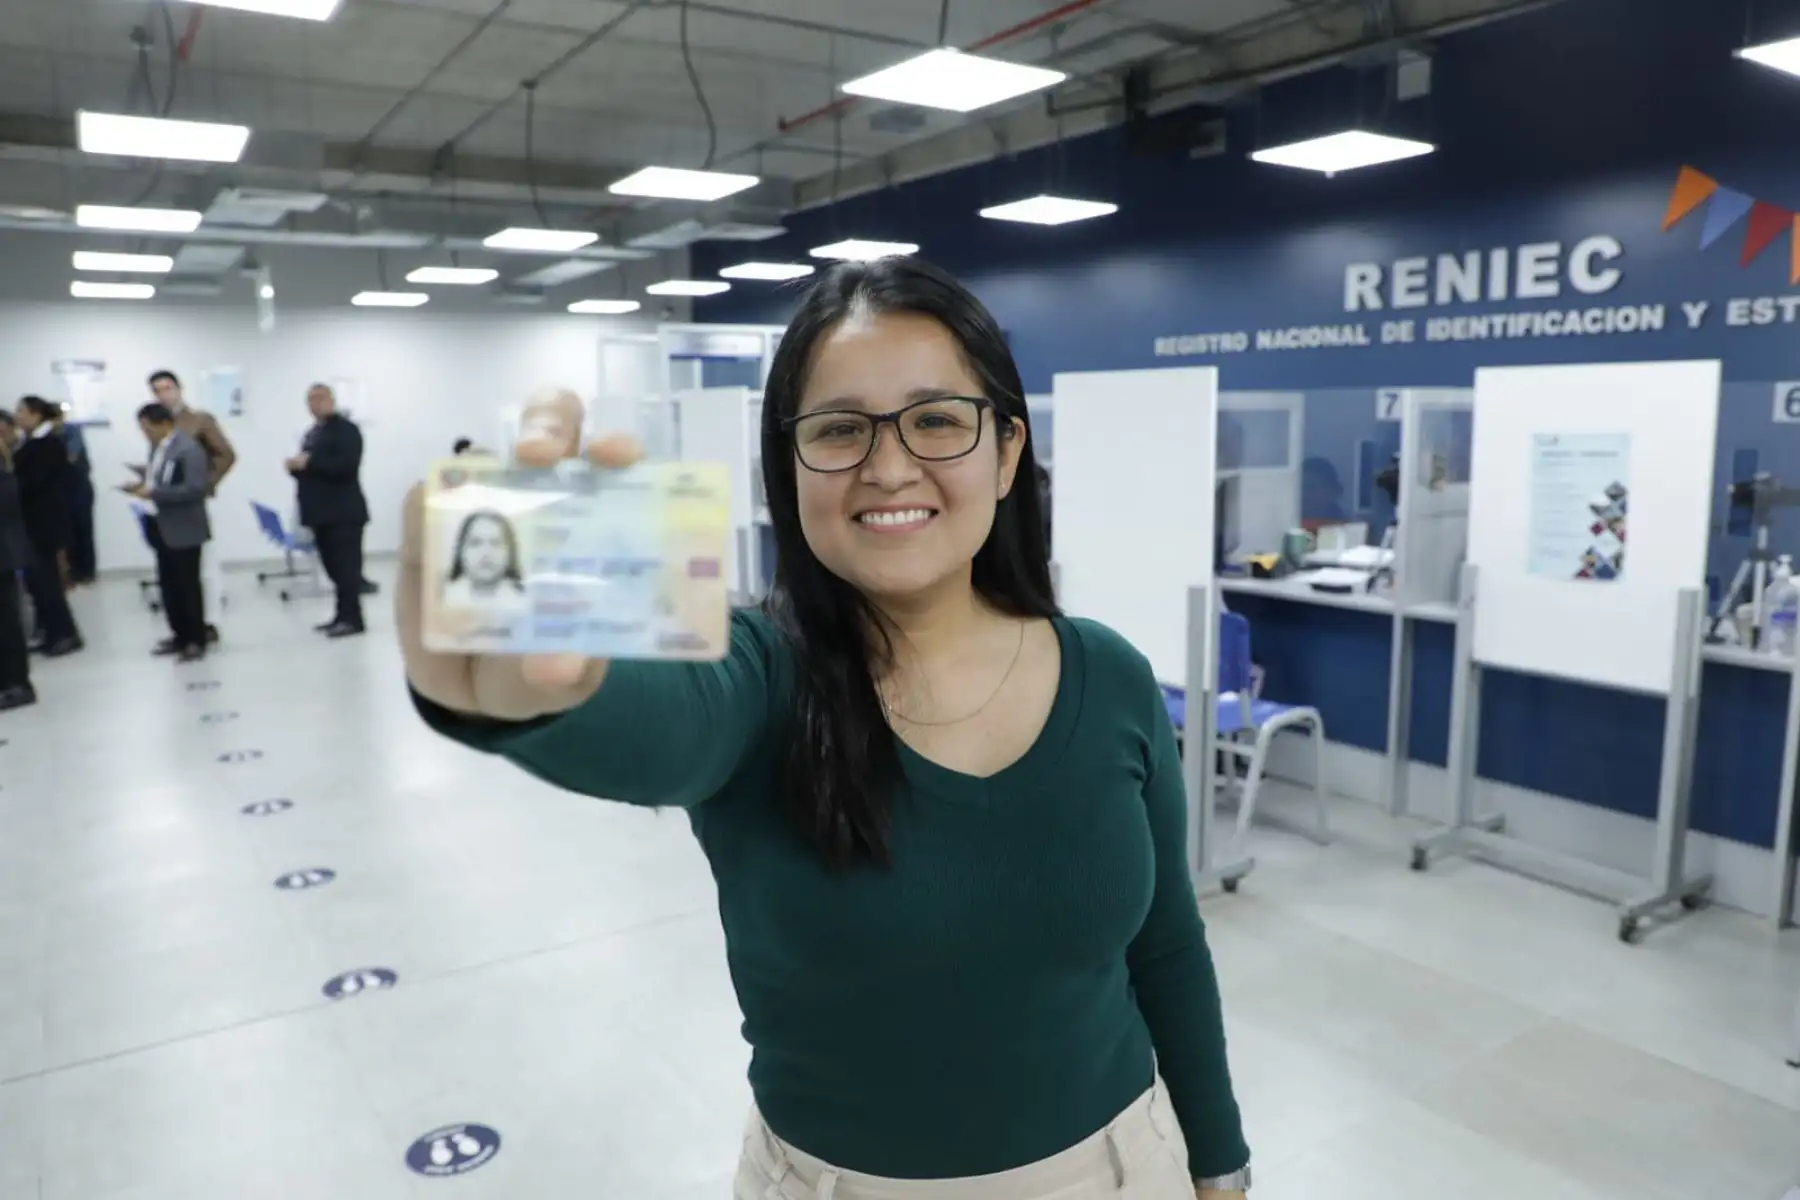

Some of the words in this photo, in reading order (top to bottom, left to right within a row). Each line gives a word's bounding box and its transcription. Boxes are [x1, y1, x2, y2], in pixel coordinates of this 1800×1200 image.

[1344, 235, 1622, 312] RENIEC
[1154, 332, 1248, 356] REGISTRO
[1256, 324, 1371, 350] NACIONAL
[1381, 320, 1415, 344] DE
[1426, 304, 1664, 341] IDENTIFICACION
[1682, 302, 1708, 328] Y
[1726, 297, 1800, 325] EST
[1384, 392, 1399, 417] 7
